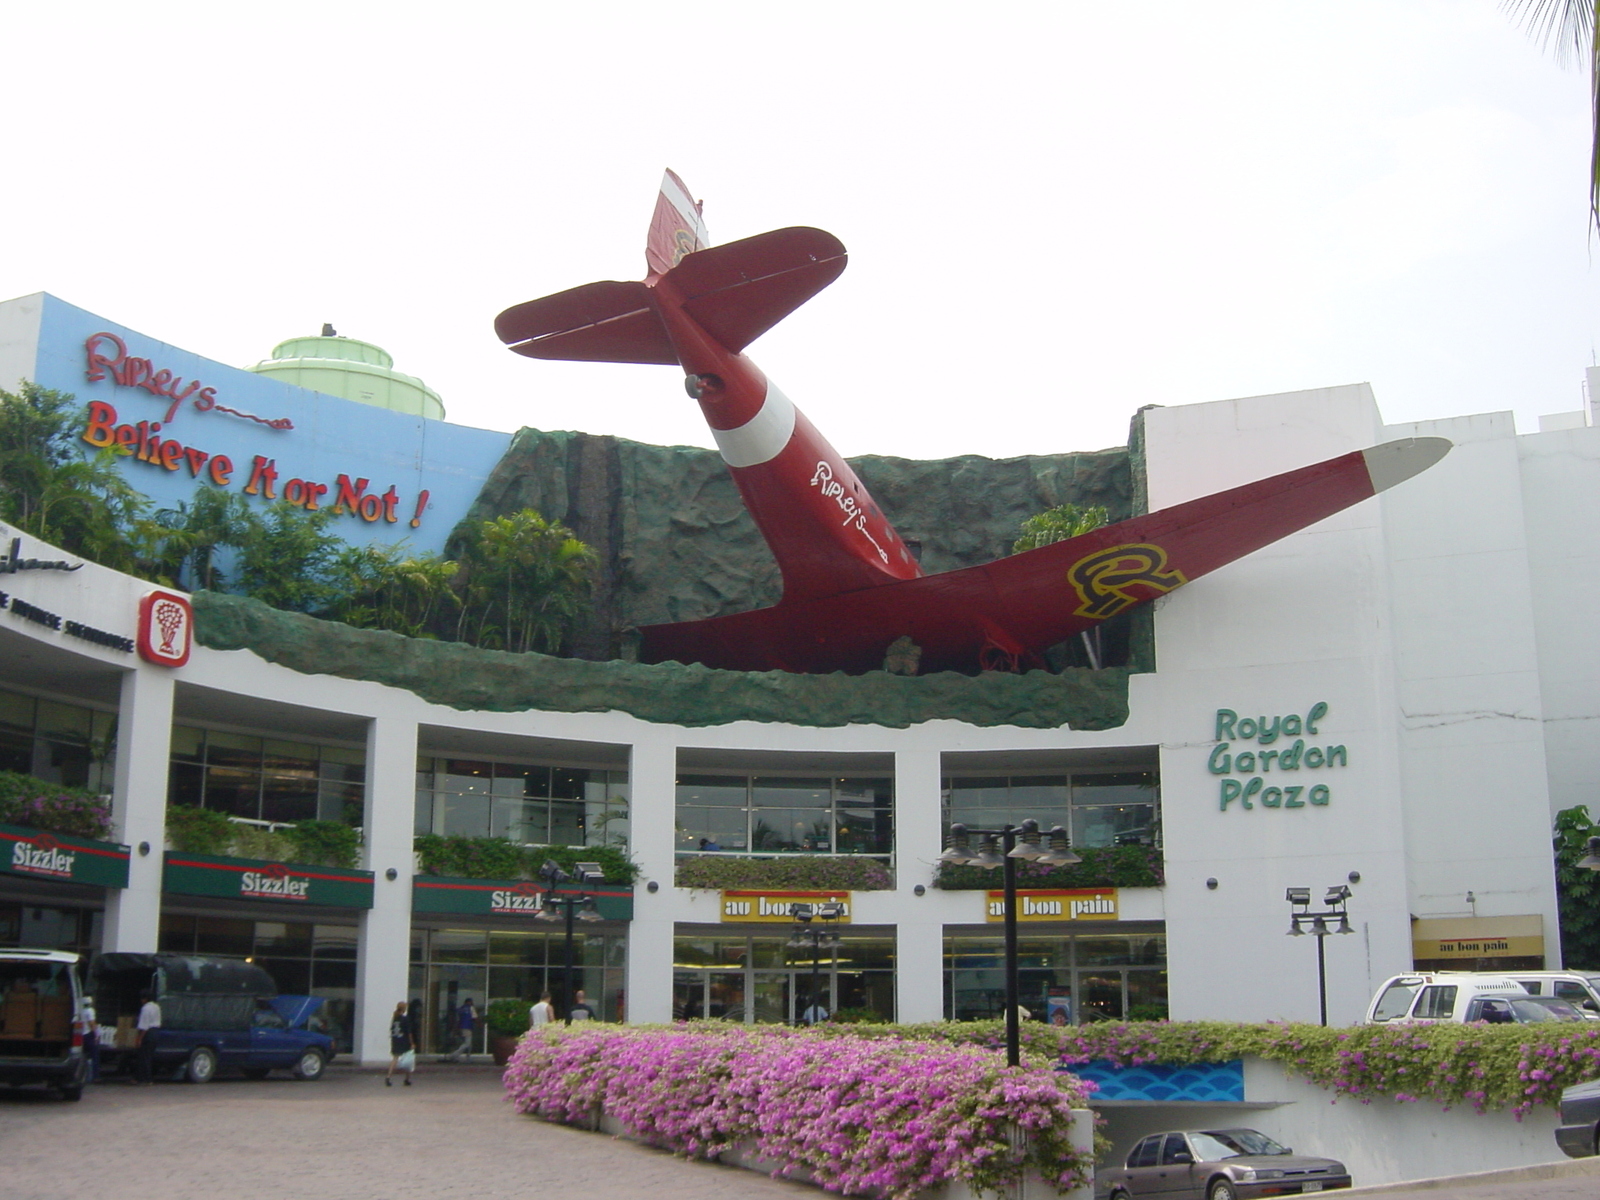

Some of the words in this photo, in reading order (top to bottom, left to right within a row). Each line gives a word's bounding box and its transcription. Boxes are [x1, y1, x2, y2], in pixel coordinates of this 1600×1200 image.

[81, 401, 234, 486] Believe
[244, 455, 279, 499] It
[284, 478, 328, 510] or
[1215, 701, 1328, 745] Royal
[1207, 739, 1347, 775] Garden
[1220, 776, 1330, 811] Plaza
[12, 841, 75, 872] Sizzler
[241, 872, 309, 896] Sizzler
[491, 890, 544, 910] Sizzl
[725, 901, 750, 915] au
[989, 902, 1006, 915] a
[1023, 896, 1062, 915] bon
[1070, 894, 1115, 919] pain
[1440, 943, 1454, 952] au
[1458, 942, 1480, 952] bon
[1483, 940, 1509, 953] pain
